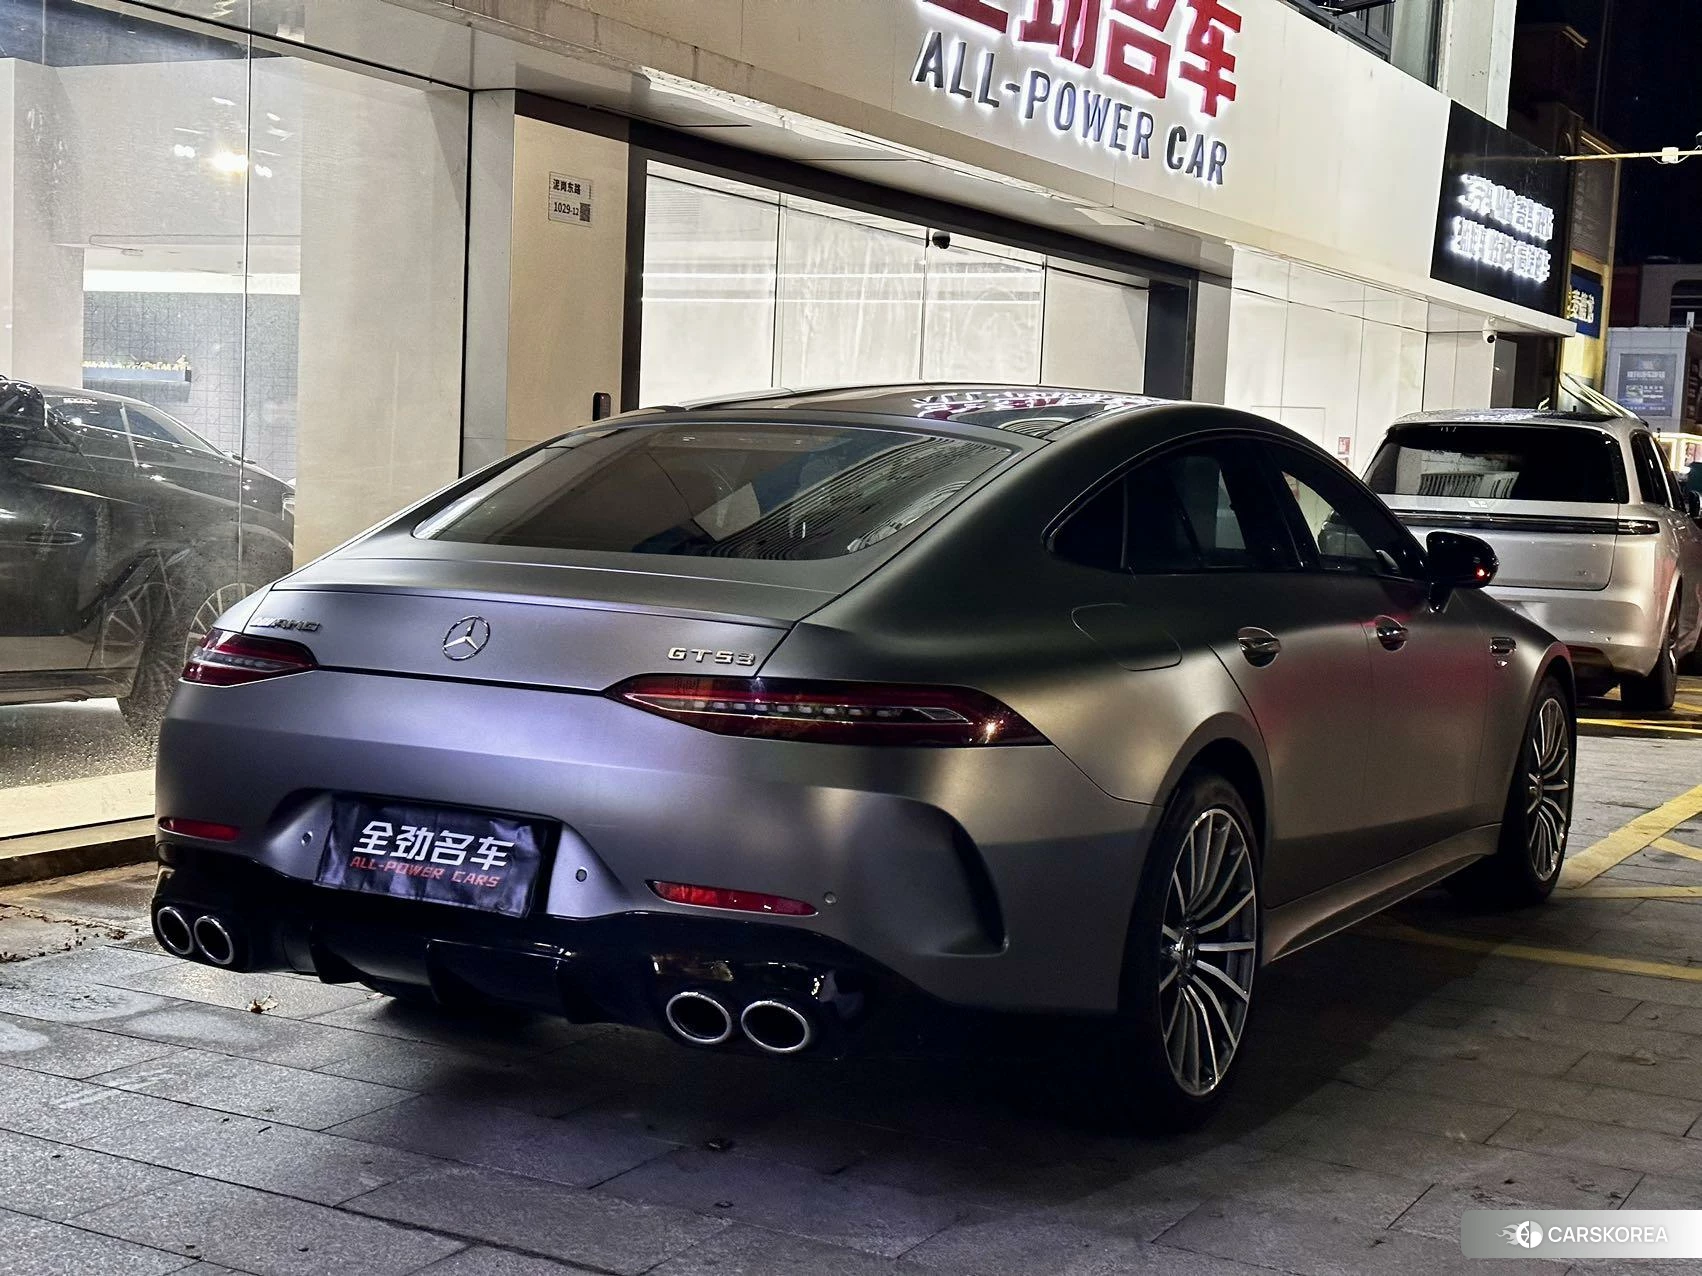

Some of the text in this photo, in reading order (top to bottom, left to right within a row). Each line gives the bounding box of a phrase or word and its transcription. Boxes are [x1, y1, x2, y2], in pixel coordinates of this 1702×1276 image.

[911, 31, 1228, 186] ALL-POWER CAR
[553, 201, 579, 216] 1029-12
[352, 820, 515, 871] 全劲名车
[350, 855, 501, 888] ALL-POWER CARS
